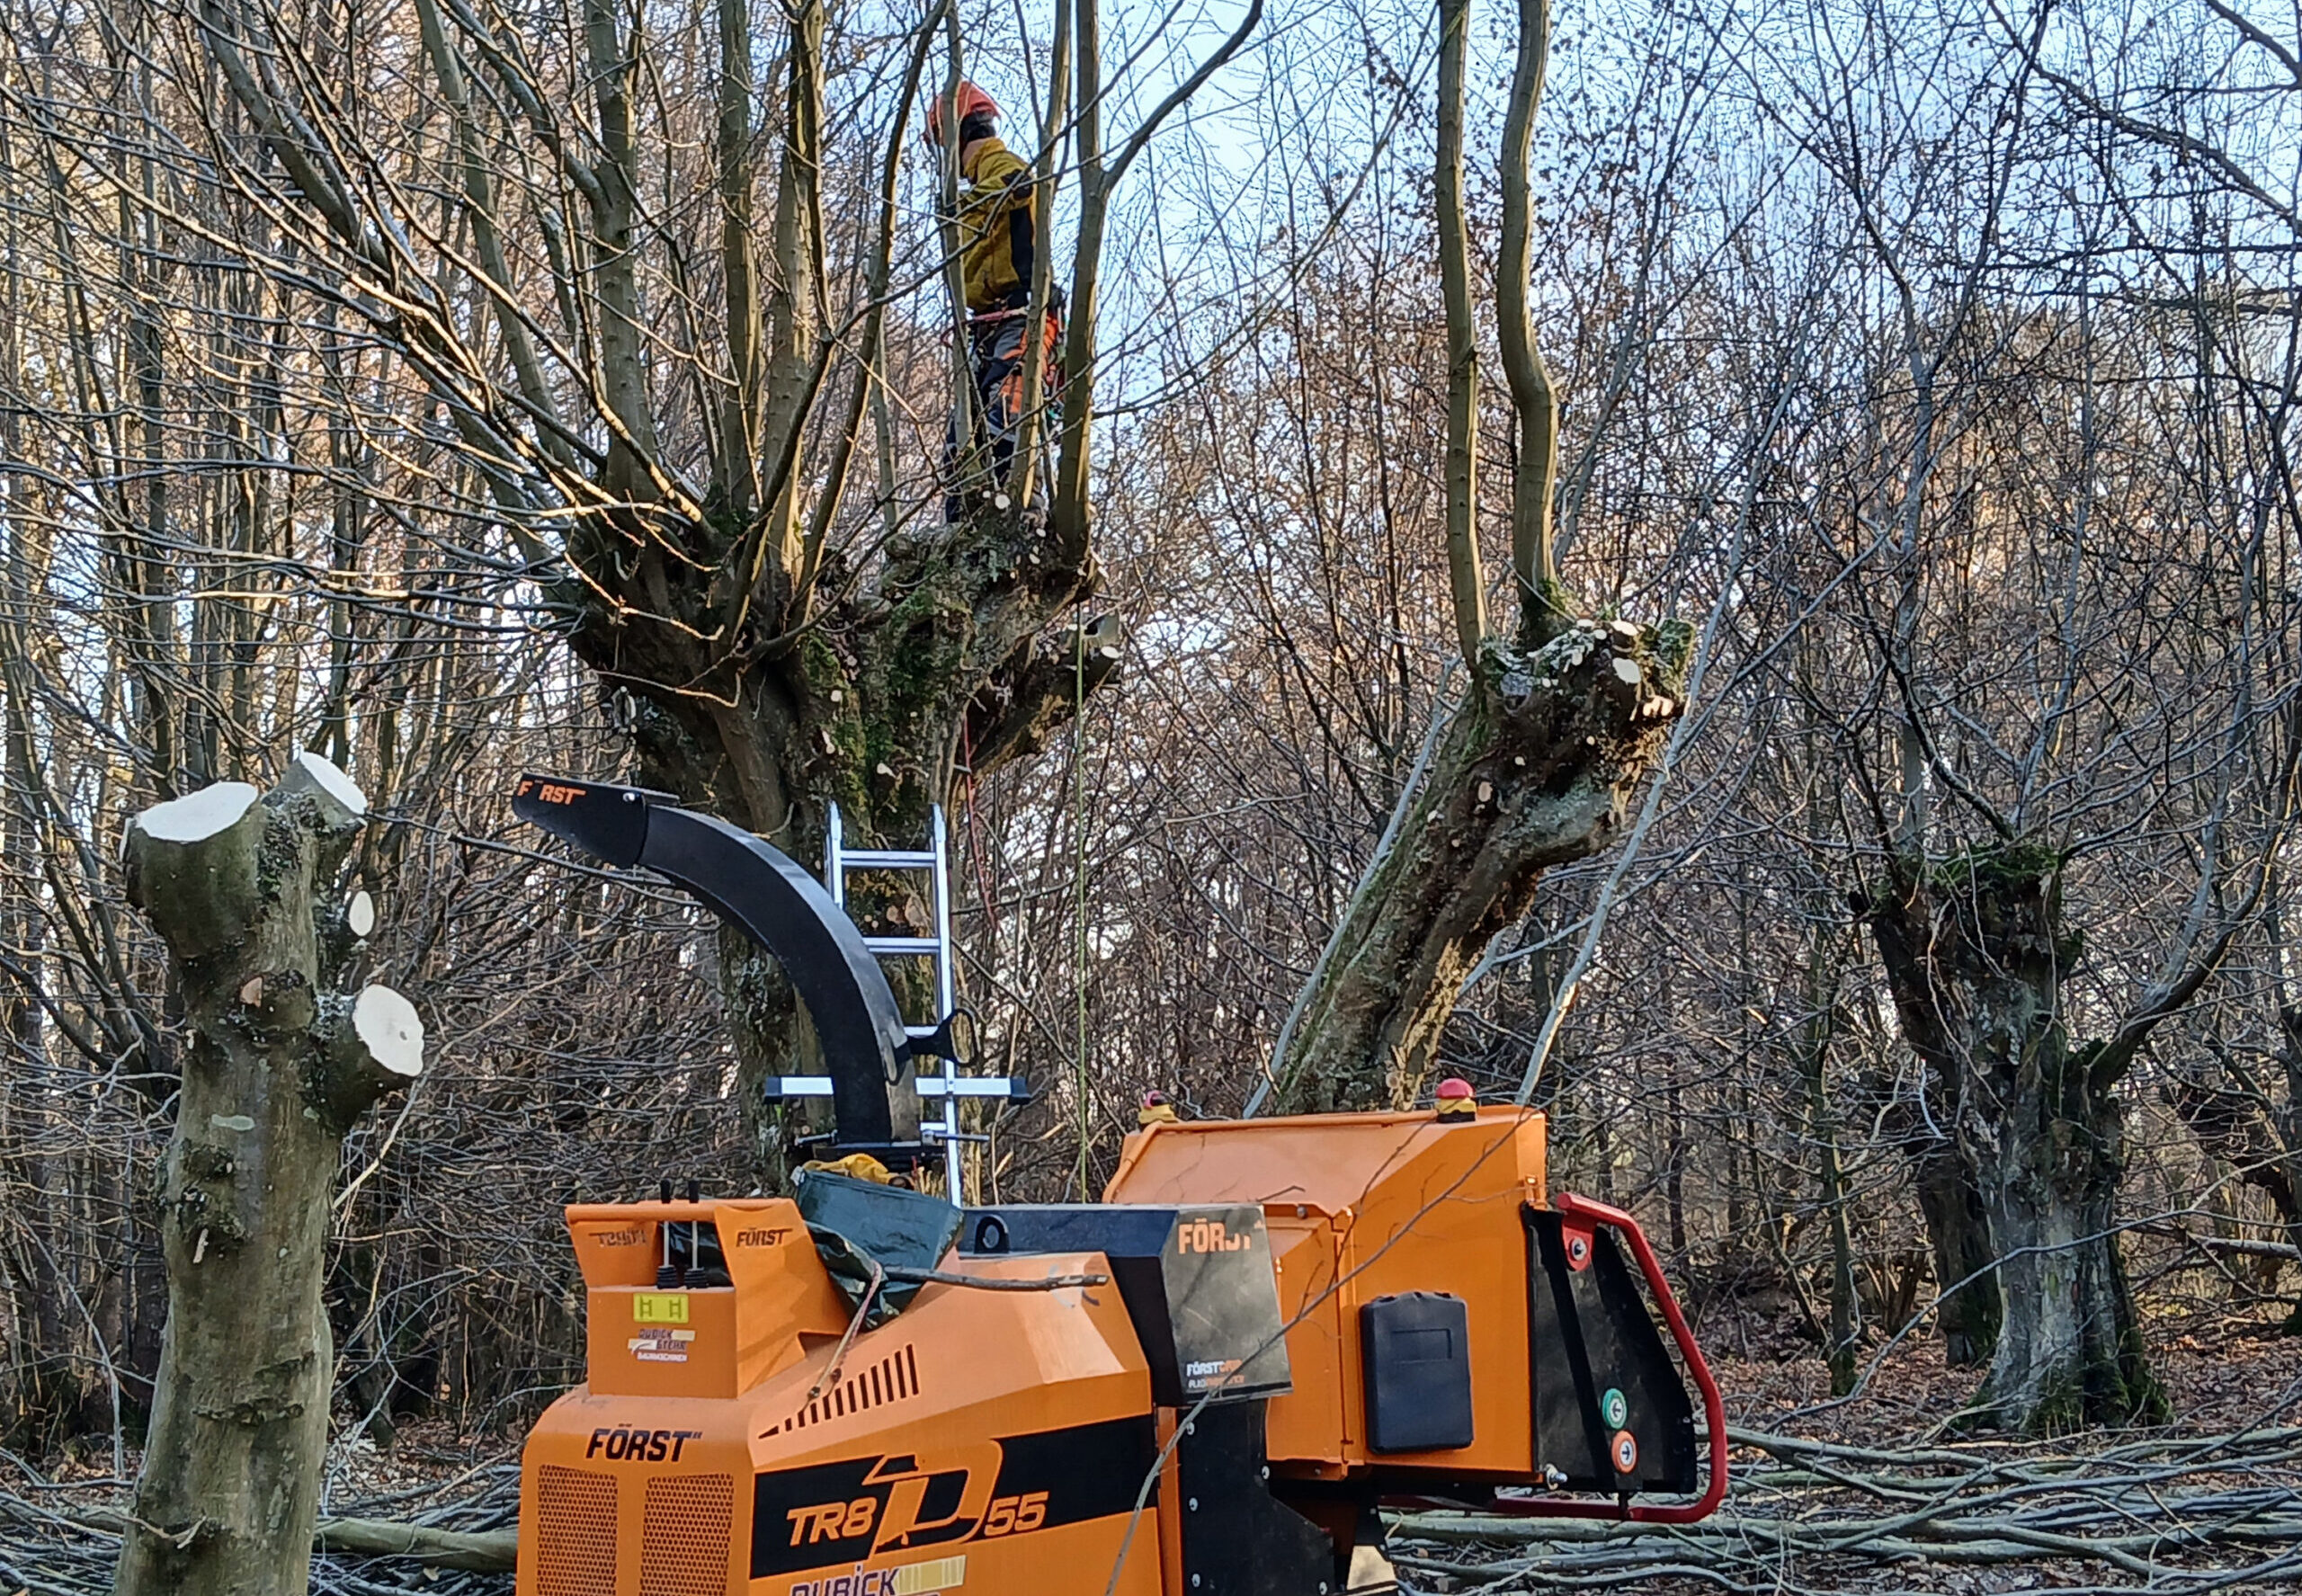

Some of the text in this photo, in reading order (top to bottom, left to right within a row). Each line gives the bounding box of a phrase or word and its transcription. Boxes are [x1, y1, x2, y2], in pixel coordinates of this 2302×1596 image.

[517, 779, 586, 805] FRST
[736, 1226, 793, 1247] FÖRST
[585, 1422, 702, 1462] FÖRST
